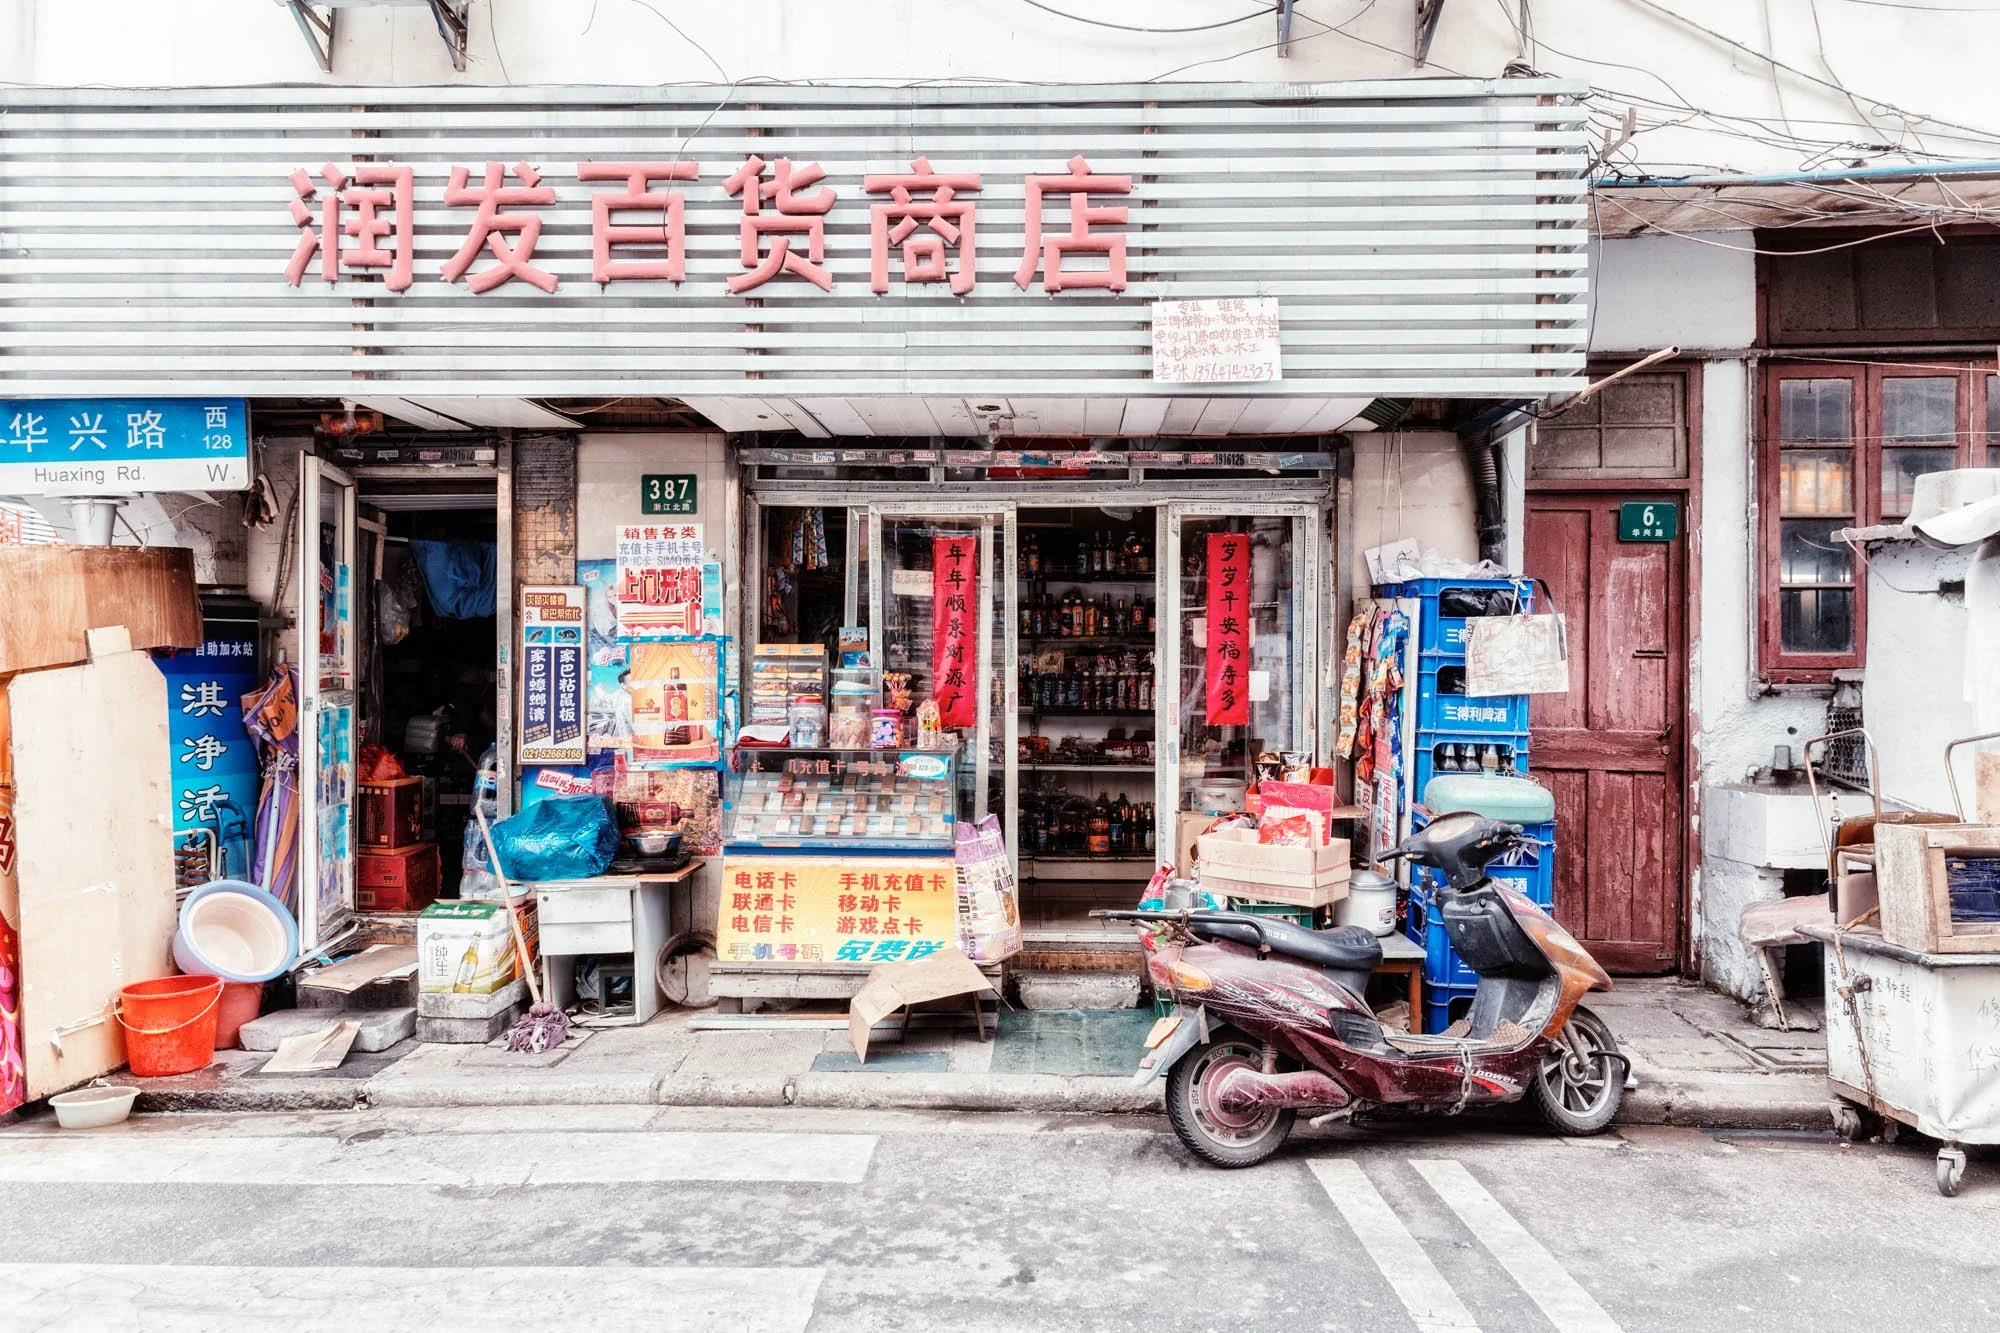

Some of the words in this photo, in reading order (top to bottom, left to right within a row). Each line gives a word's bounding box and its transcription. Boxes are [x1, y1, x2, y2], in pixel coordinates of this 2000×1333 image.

[283, 154, 1133, 293] 润发百货商店
[204, 406, 228, 429] 西
[9, 410, 168, 453] 华兴路
[202, 434, 232, 450] 128
[34, 466, 105, 485] Huaxing
[117, 466, 145, 481] Rd.
[650, 480, 689, 499] 387
[624, 526, 697, 539] 销售各类
[619, 541, 702, 555] 充值卡手机卡号
[618, 567, 701, 603] 上门开锁
[945, 543, 967, 712] 年年顺景财源广
[1218, 540, 1241, 711] 岁岁平安福寿多
[195, 641, 254, 657] 自助加水站
[1445, 705, 1507, 722] 三得利啤酒
[735, 872, 797, 889] 电话卡
[839, 873, 947, 891] 手机充值卡
[732, 893, 796, 911] 联通卡
[838, 894, 902, 912] 移动卡
[731, 915, 795, 933] 电信卡
[836, 917, 923, 935] 游戏点卡
[435, 943, 449, 977] 纯生
[728, 943, 824, 960] 手机号码
